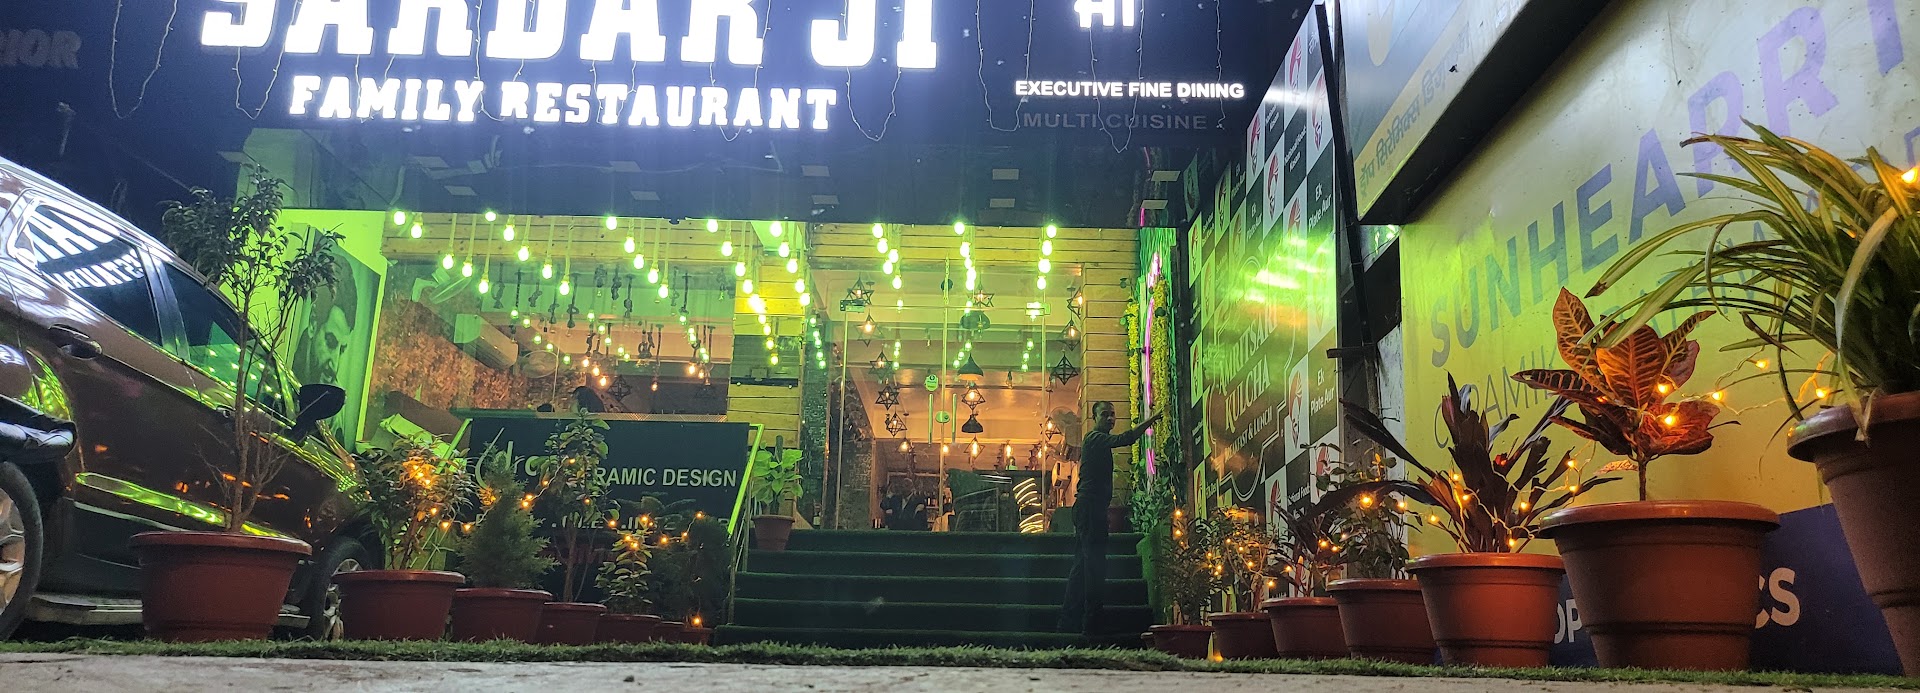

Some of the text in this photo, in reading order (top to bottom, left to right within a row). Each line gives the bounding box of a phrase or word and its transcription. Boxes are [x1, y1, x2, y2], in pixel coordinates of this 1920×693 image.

[1015, 80, 1245, 99] EXECUTIVE FINE DINING
[289, 75, 838, 131] FAMILY RESTAURANT
[1023, 112, 1208, 130] MULTI CUISINE
[1225, 354, 1271, 434] KULCHA
[662, 469, 737, 487] DESIGN
